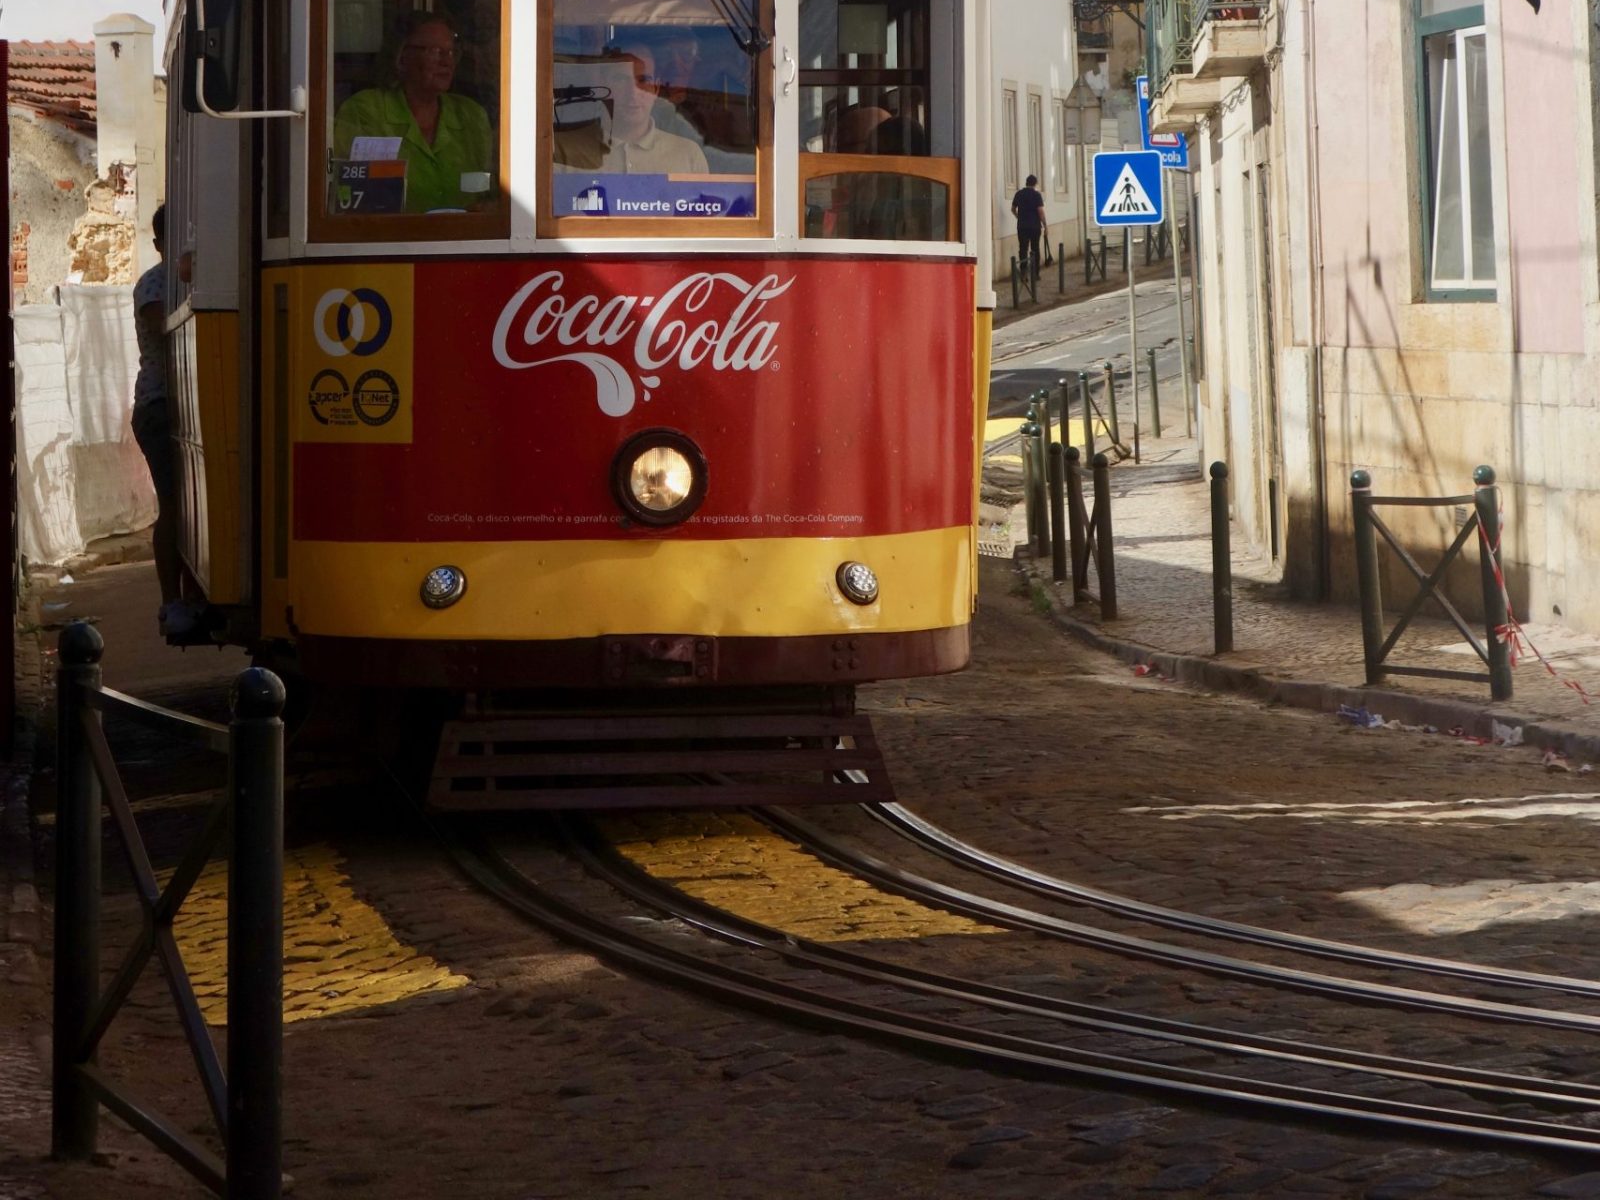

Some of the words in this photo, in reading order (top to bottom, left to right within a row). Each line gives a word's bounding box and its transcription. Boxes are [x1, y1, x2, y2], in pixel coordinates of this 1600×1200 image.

[1162, 150, 1181, 163] cola
[342, 166, 367, 179] 28E
[616, 198, 671, 212] Inverte
[675, 198, 722, 215] Graça
[492, 270, 797, 417] Coca-Cola
[427, 513, 475, 523] Coca-Cola,
[477, 515, 483, 523] o
[485, 513, 510, 523] disco
[512, 513, 555, 523] vermelho
[557, 515, 563, 523] e
[566, 515, 572, 523] a
[574, 513, 608, 525] garrafa
[703, 514, 749, 525] registadas
[752, 514, 763, 523] da
[766, 513, 782, 523] The
[783, 513, 826, 523] Coca-Cola
[827, 513, 865, 524] Company.
